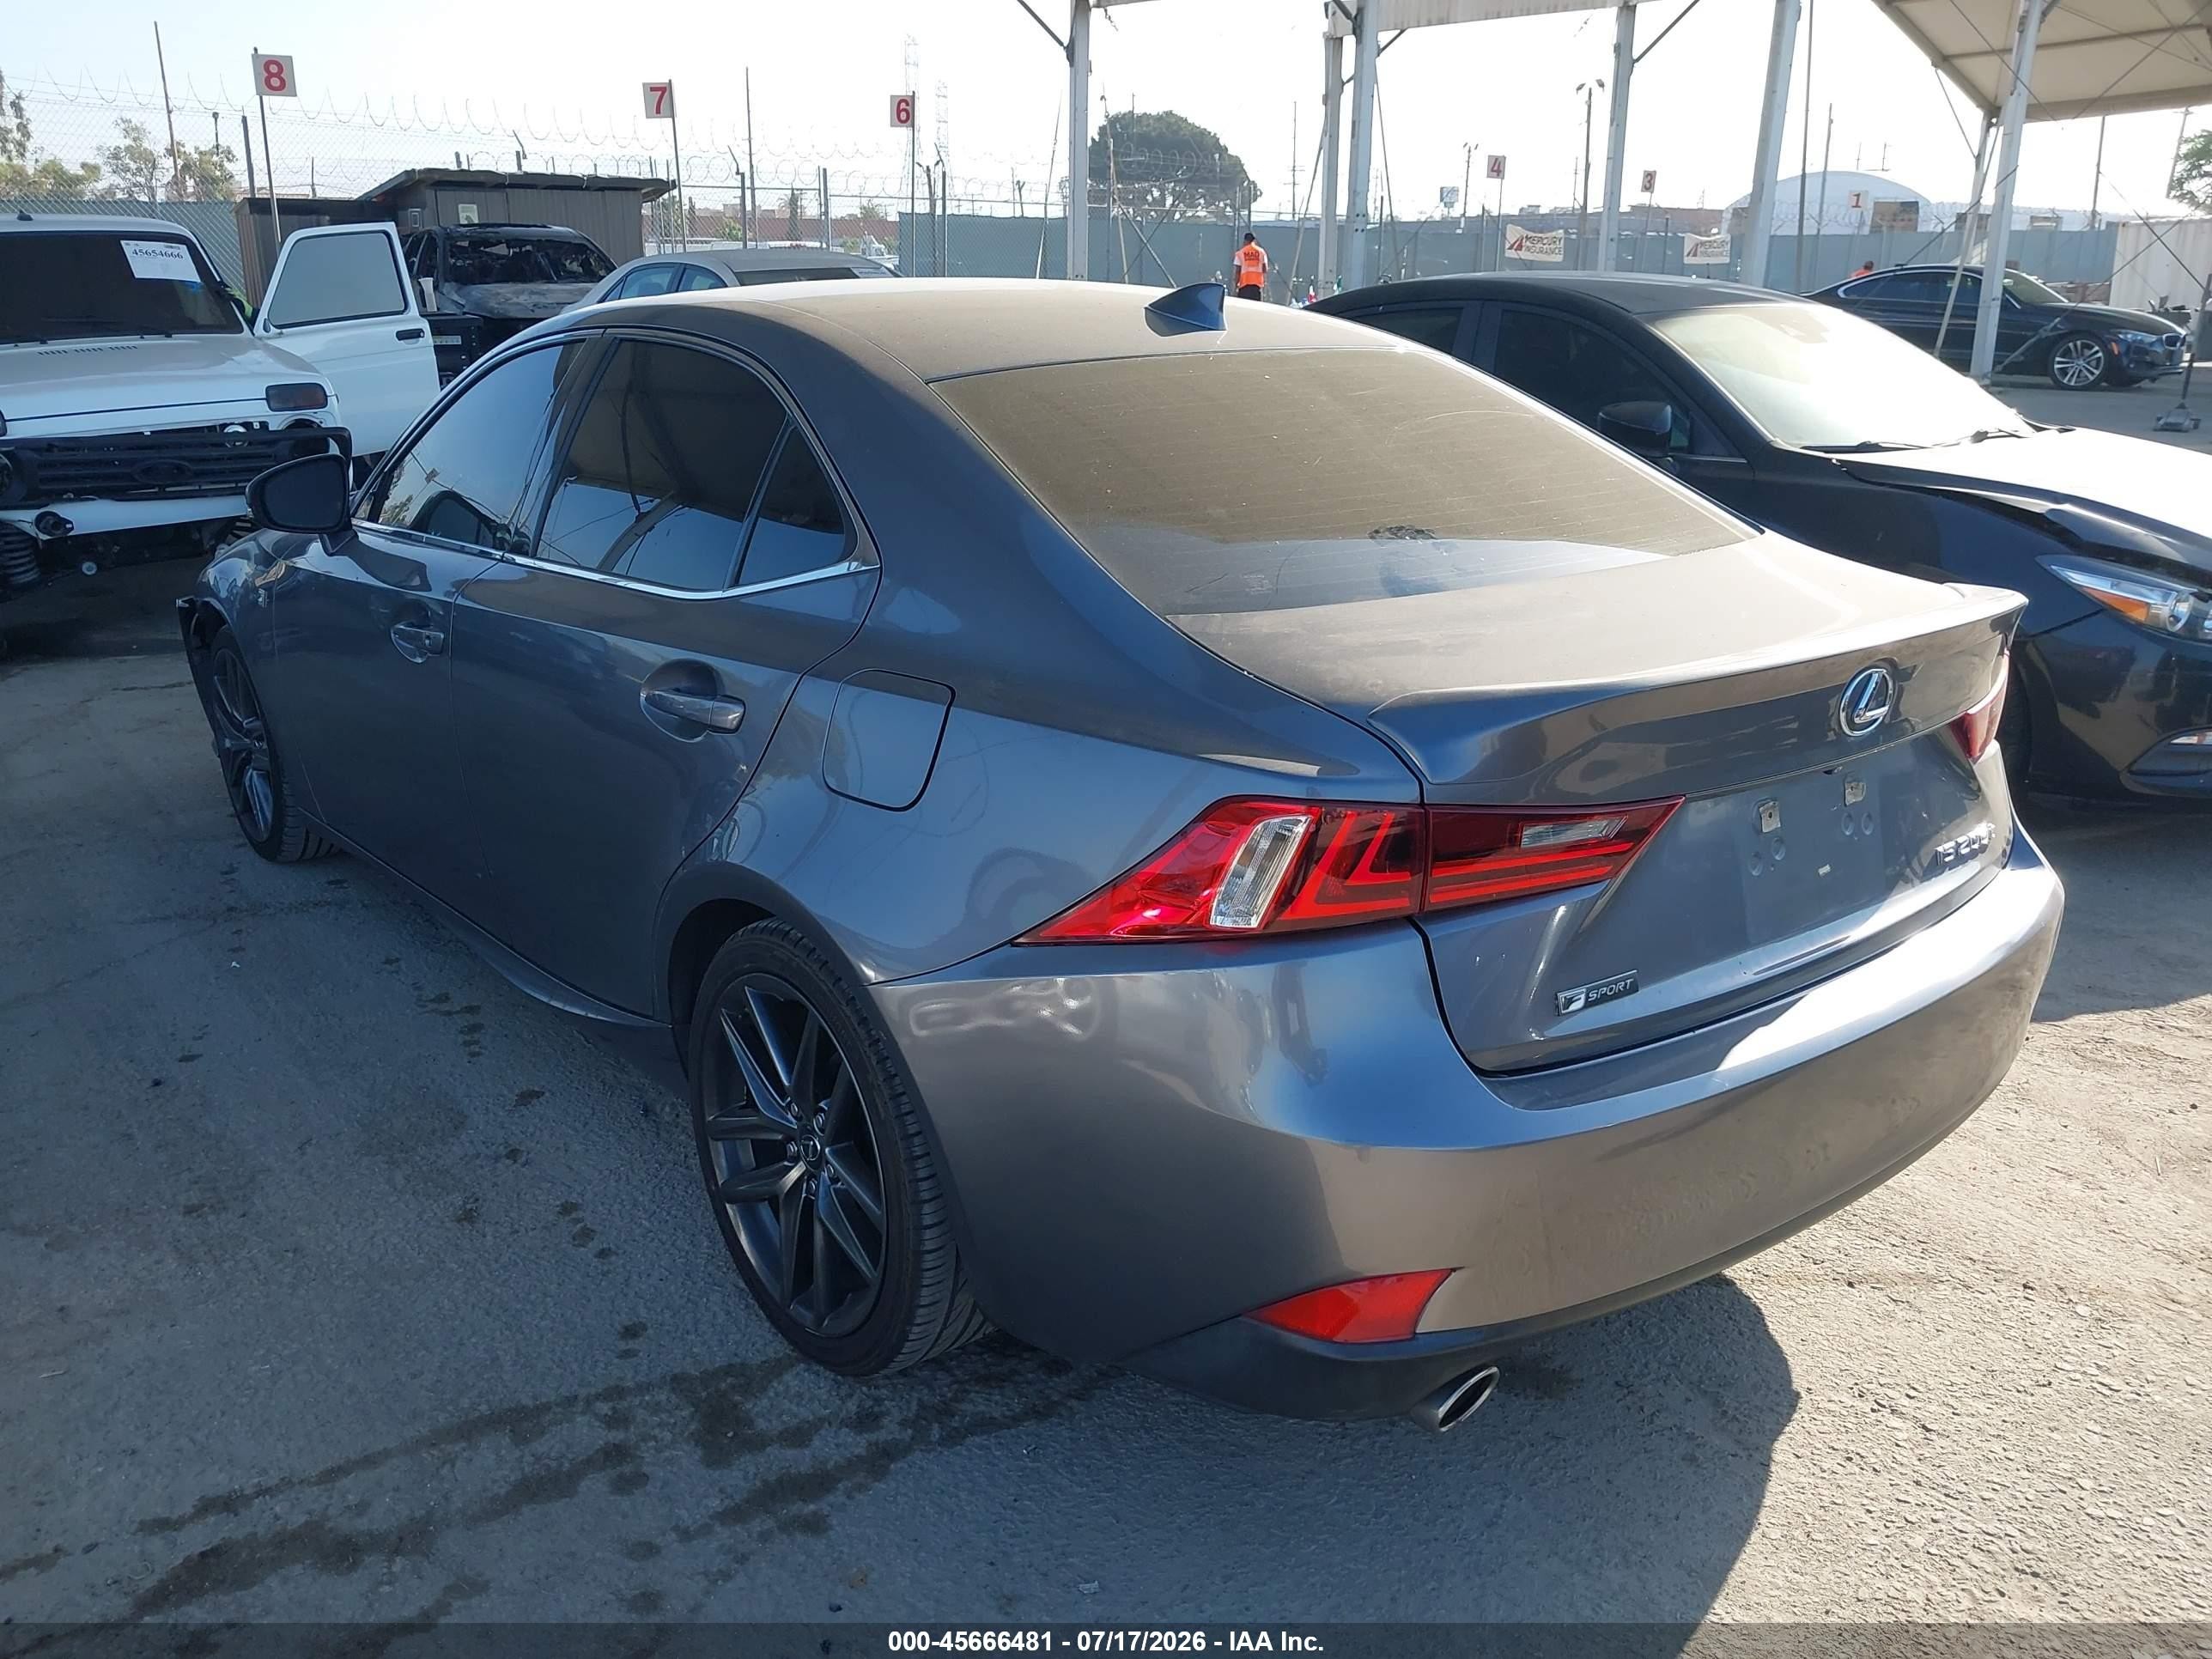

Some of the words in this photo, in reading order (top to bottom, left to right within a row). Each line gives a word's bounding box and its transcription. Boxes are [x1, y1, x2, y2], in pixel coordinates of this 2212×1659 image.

[264, 59, 287, 92] 8
[650, 87, 667, 114] 7
[896, 98, 910, 124] 6
[1491, 157, 1502, 177] 4
[1644, 173, 1653, 191] 3
[1851, 192, 1862, 209] 1
[1525, 234, 1563, 246] MERCURY
[131, 248, 184, 259] 45654666
[1524, 246, 1563, 256] INSURANCE
[1587, 978, 1634, 1002] SPORT
